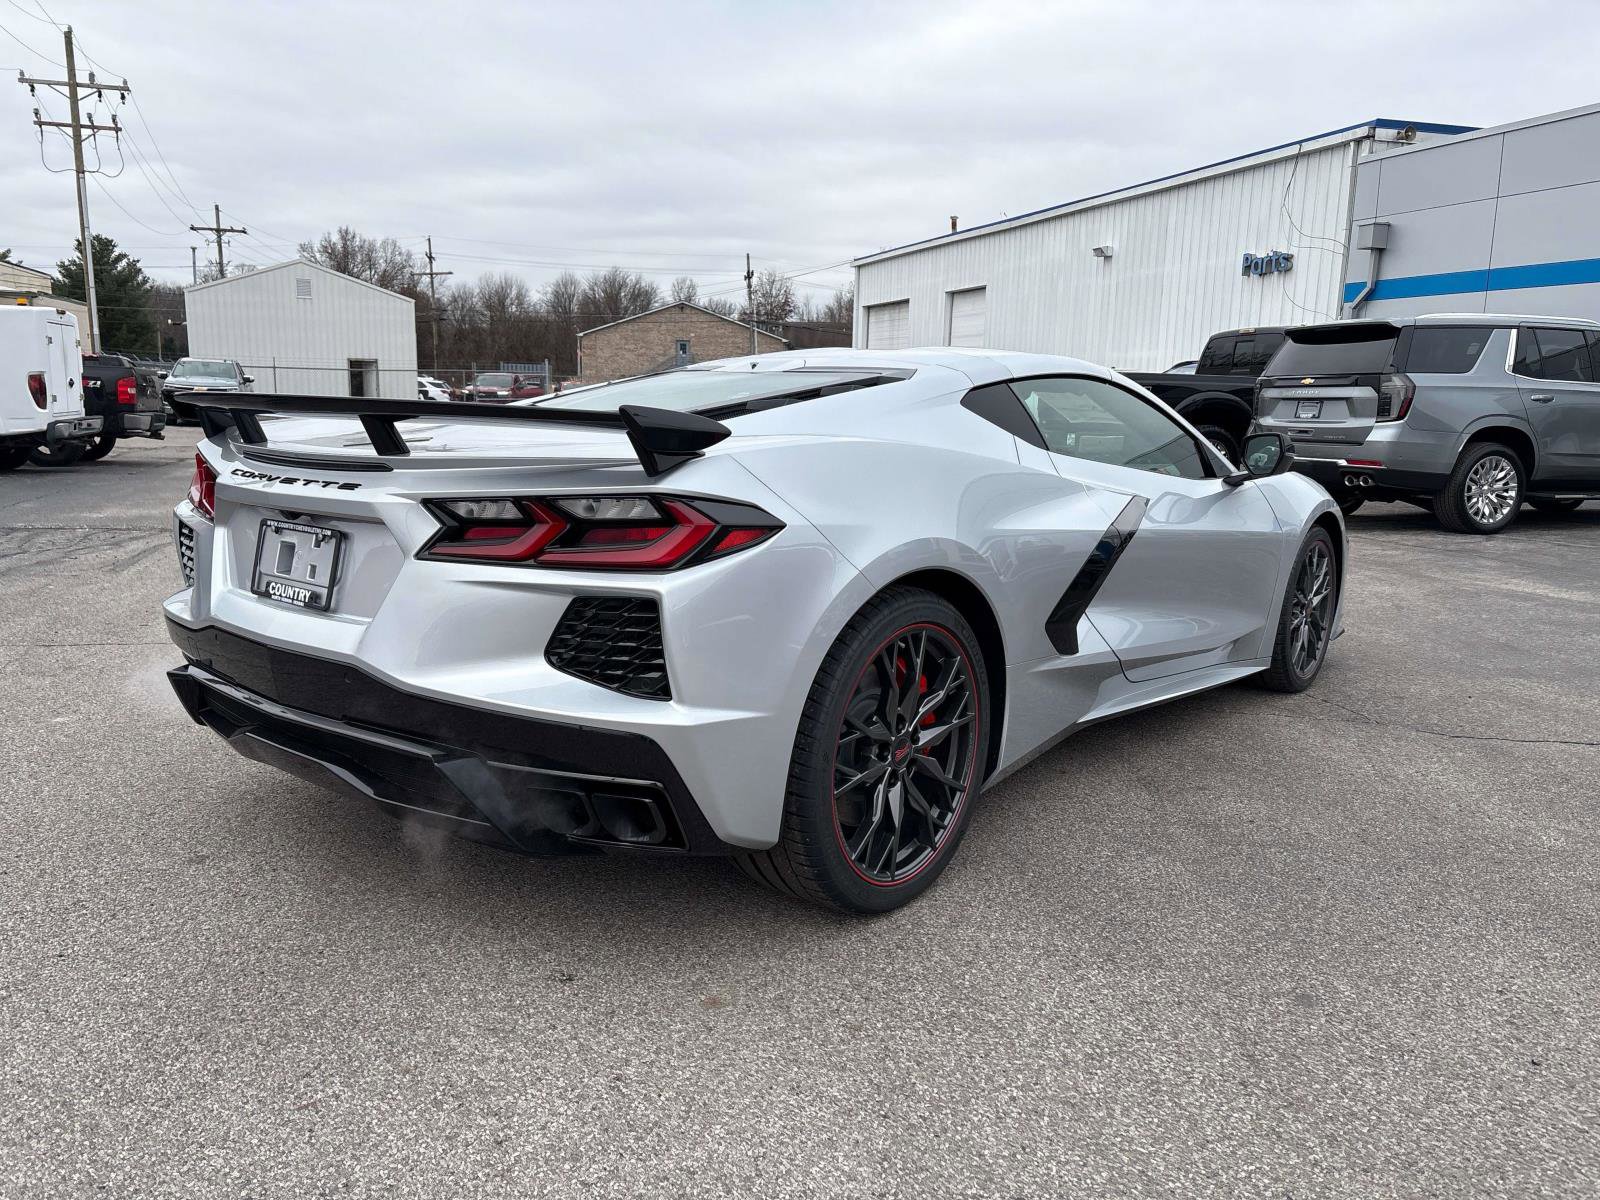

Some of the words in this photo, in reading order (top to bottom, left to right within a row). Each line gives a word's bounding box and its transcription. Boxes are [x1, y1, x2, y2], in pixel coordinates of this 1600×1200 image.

[1242, 251, 1294, 276] Parts
[231, 468, 362, 491] CORVETTE
[269, 582, 312, 602] COUNTRY
